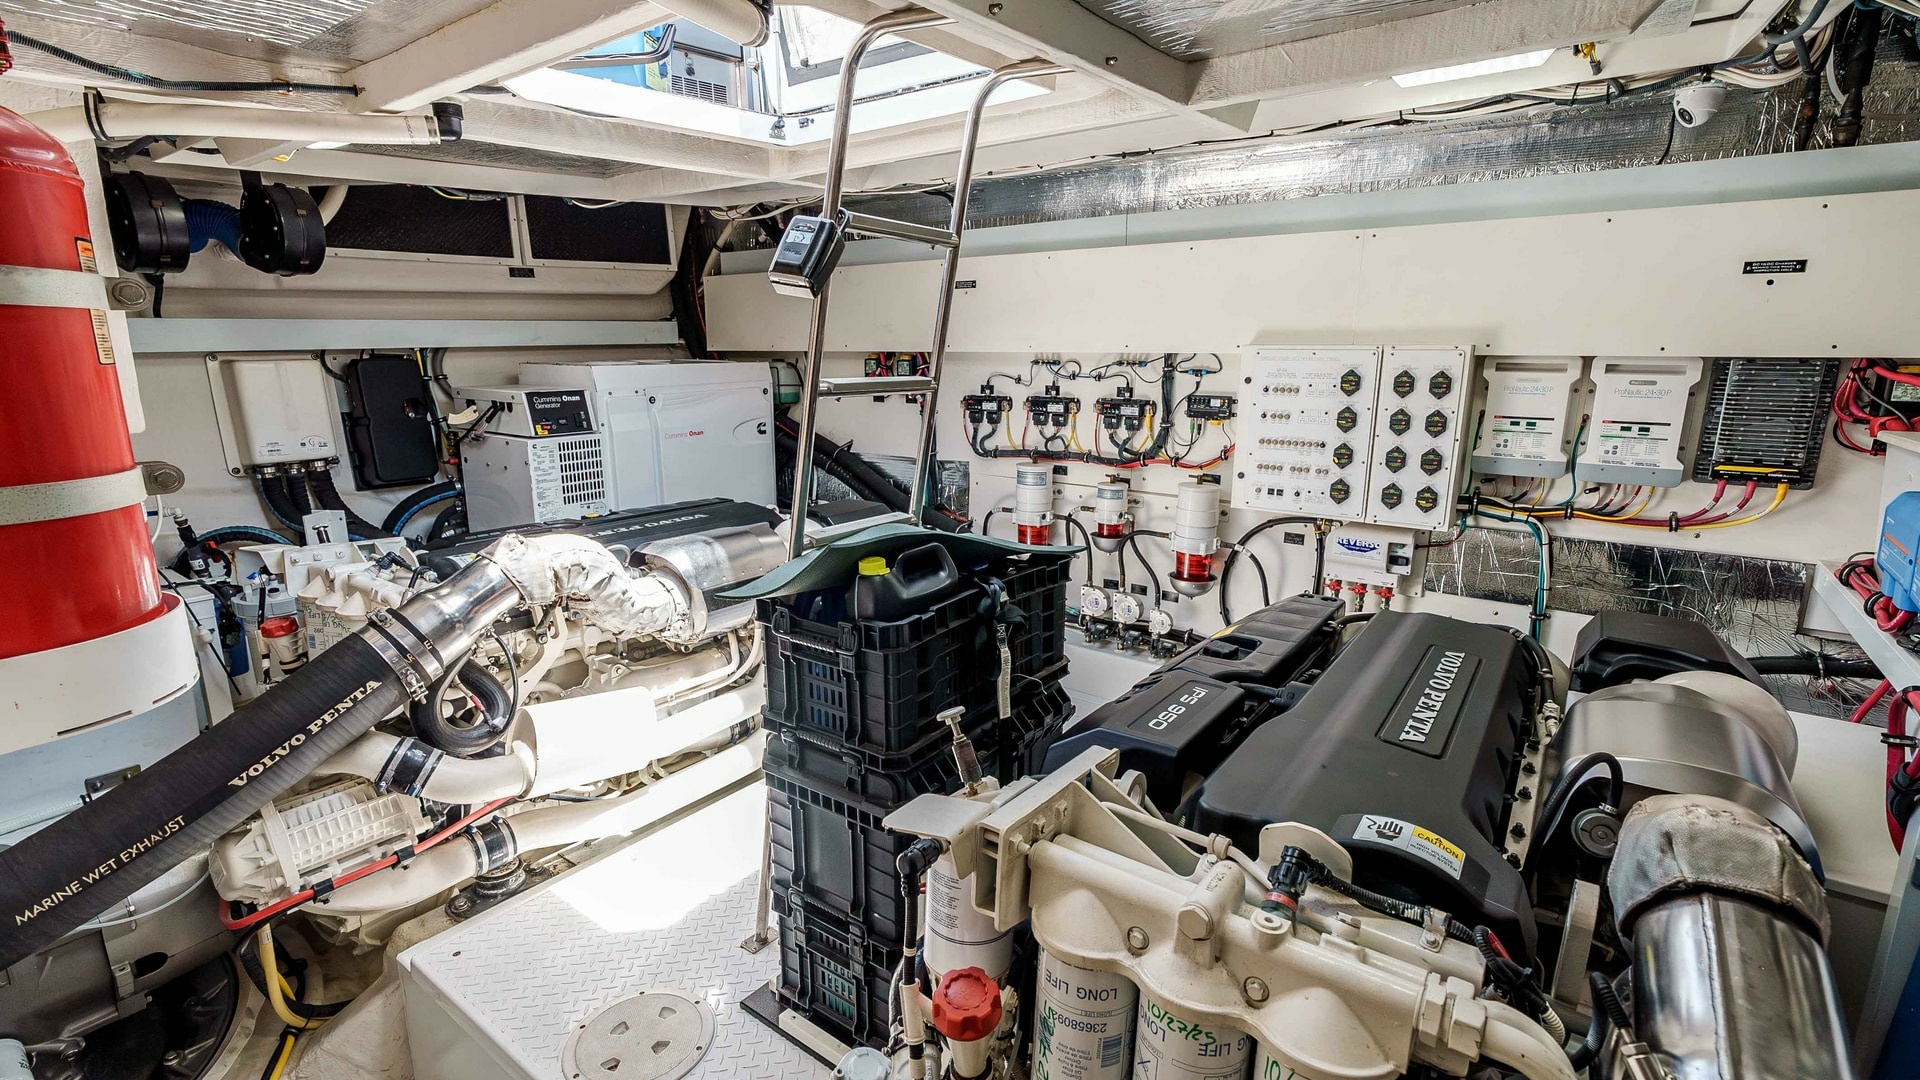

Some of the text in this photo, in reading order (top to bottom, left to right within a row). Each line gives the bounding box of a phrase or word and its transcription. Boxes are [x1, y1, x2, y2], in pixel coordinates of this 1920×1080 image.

[533, 395, 562, 404] Cummins
[1503, 384, 1530, 392] ProNautic
[1613, 387, 1643, 396] ProNautic
[664, 431, 688, 440] Cummins
[583, 513, 711, 539] VOLVO PENT
[1336, 536, 1382, 549] REVERSO
[1148, 686, 1209, 730] IPS 950
[1398, 651, 1466, 742] VOLVO PENTA
[228, 680, 382, 787] VOLVO PENTA
[1410, 843, 1458, 872] INJECTOR SYSTEM
[1416, 842, 1454, 865] HIGH VOLTAGE
[1417, 832, 1459, 859] CAUTION
[14, 815, 186, 926] MARINE WET EXHAUST
[1045, 968, 1118, 1001] LONG LIFE
[1147, 999, 1217, 1046] 10/27/25
[1198, 1042, 1231, 1058] LIFE
